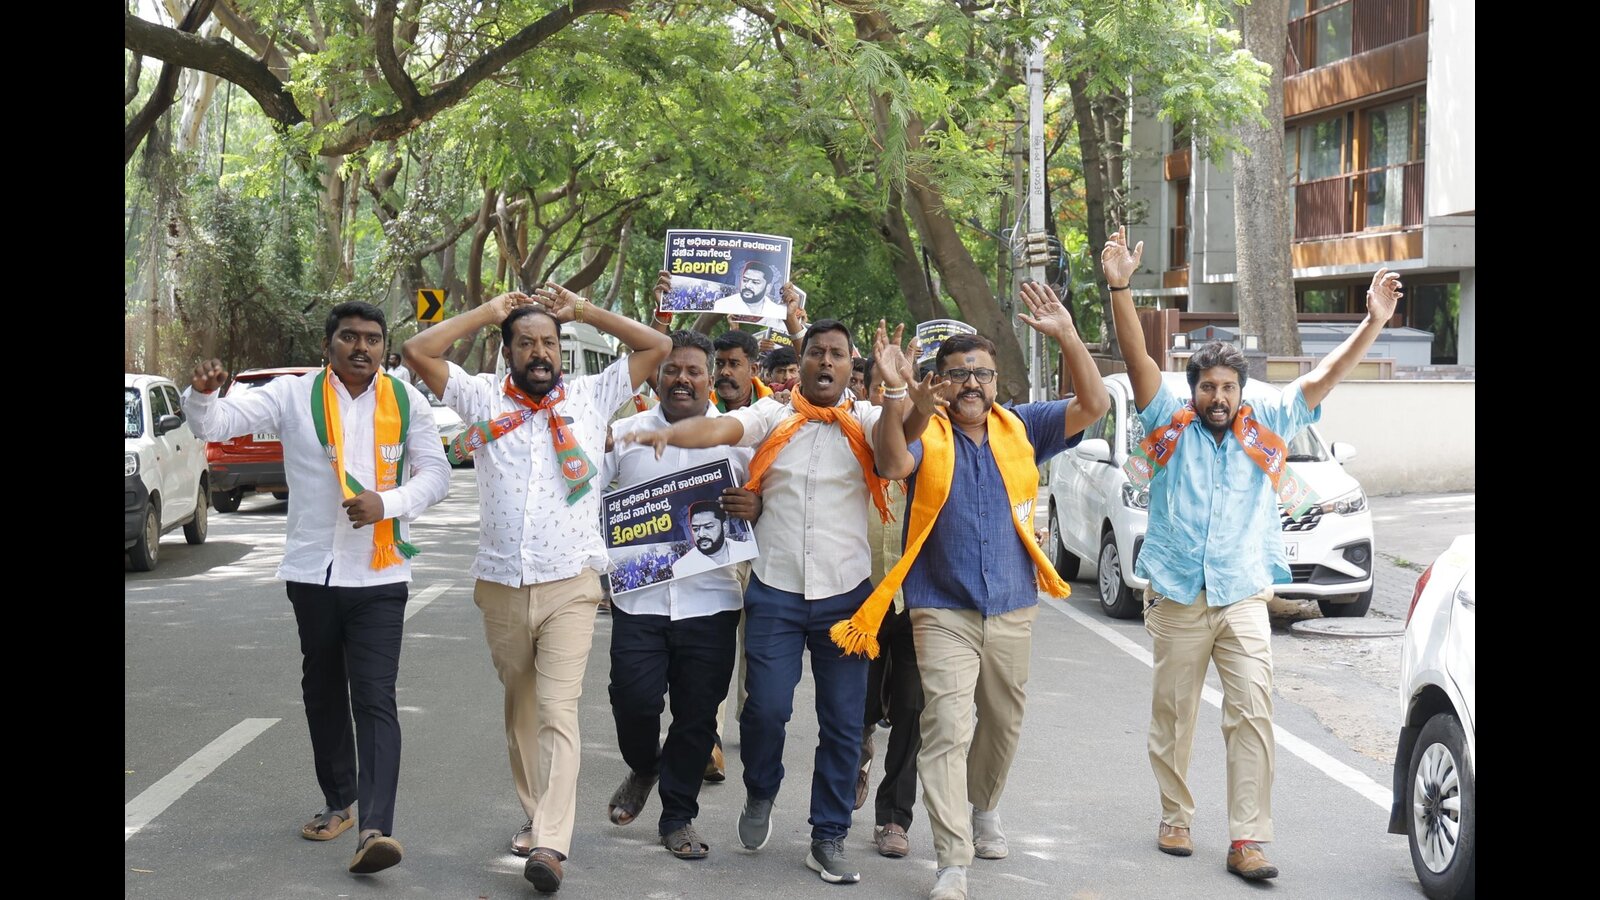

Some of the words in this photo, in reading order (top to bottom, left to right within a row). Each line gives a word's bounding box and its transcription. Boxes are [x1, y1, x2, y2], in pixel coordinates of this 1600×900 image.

[672, 248, 694, 257] ಸಚಿವ
[696, 249, 733, 260] ನಾಗೇಂದ್ರ
[673, 237, 685, 248] ದಕ್ಷ
[687, 237, 716, 248] ಅಧಿಕಾರಿ
[717, 239, 741, 249] ಸಾವಿಗೆ
[742, 242, 782, 252] ಕಾರಣರಾದ
[671, 258, 729, 275] ತೊಲಗಲಿ
[609, 500, 621, 511] ದಕ್ಷ
[622, 489, 650, 507] ಅಧಿಕಾರಿ
[651, 481, 677, 497] ಸಾವಿಗೆ
[678, 469, 722, 489] ಕಾರಣರಾದ
[609, 510, 631, 525] ಸಚಿವ
[632, 498, 672, 516] ನಾಗೇಂದ್ರ
[611, 513, 673, 545] ತೊಲಗಲಿ
